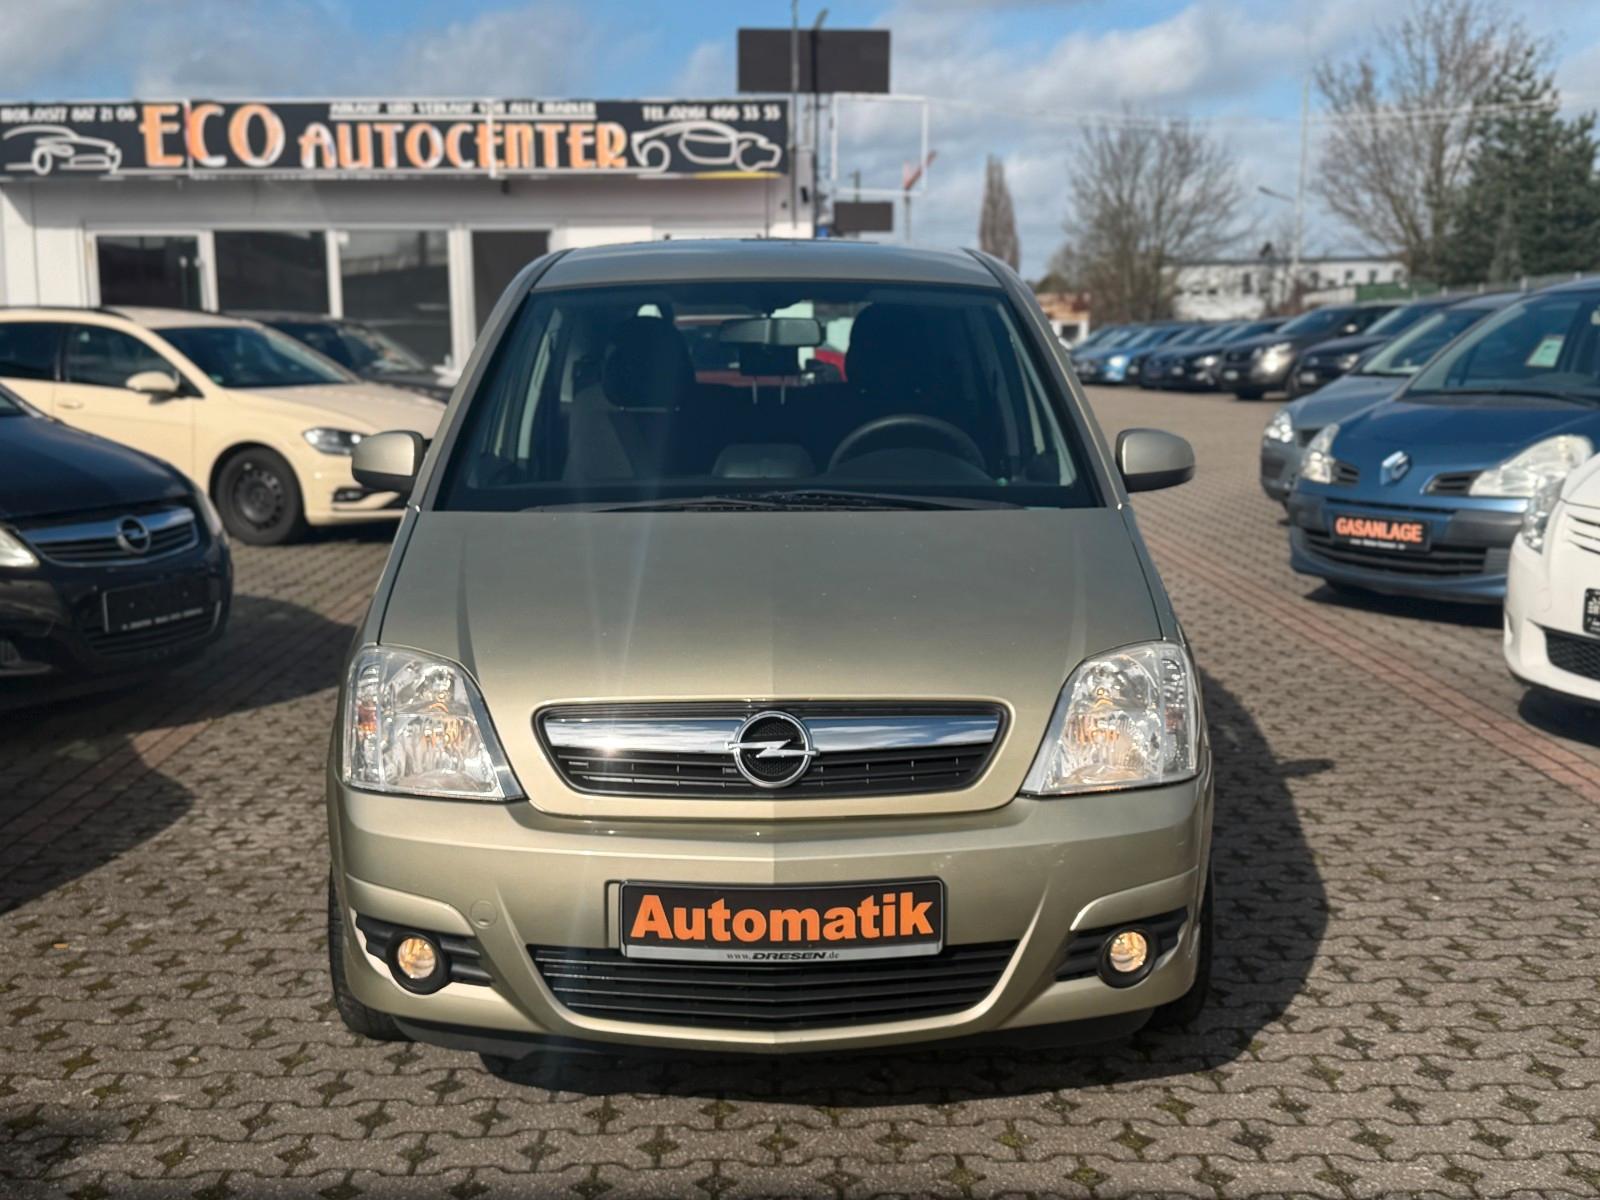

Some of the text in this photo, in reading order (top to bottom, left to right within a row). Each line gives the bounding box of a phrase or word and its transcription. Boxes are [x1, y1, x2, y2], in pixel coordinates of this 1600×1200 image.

[139, 104, 627, 169] ECO AUTOCENTER
[1335, 517, 1423, 543] GASANLAGE
[630, 892, 934, 942] Automatik
